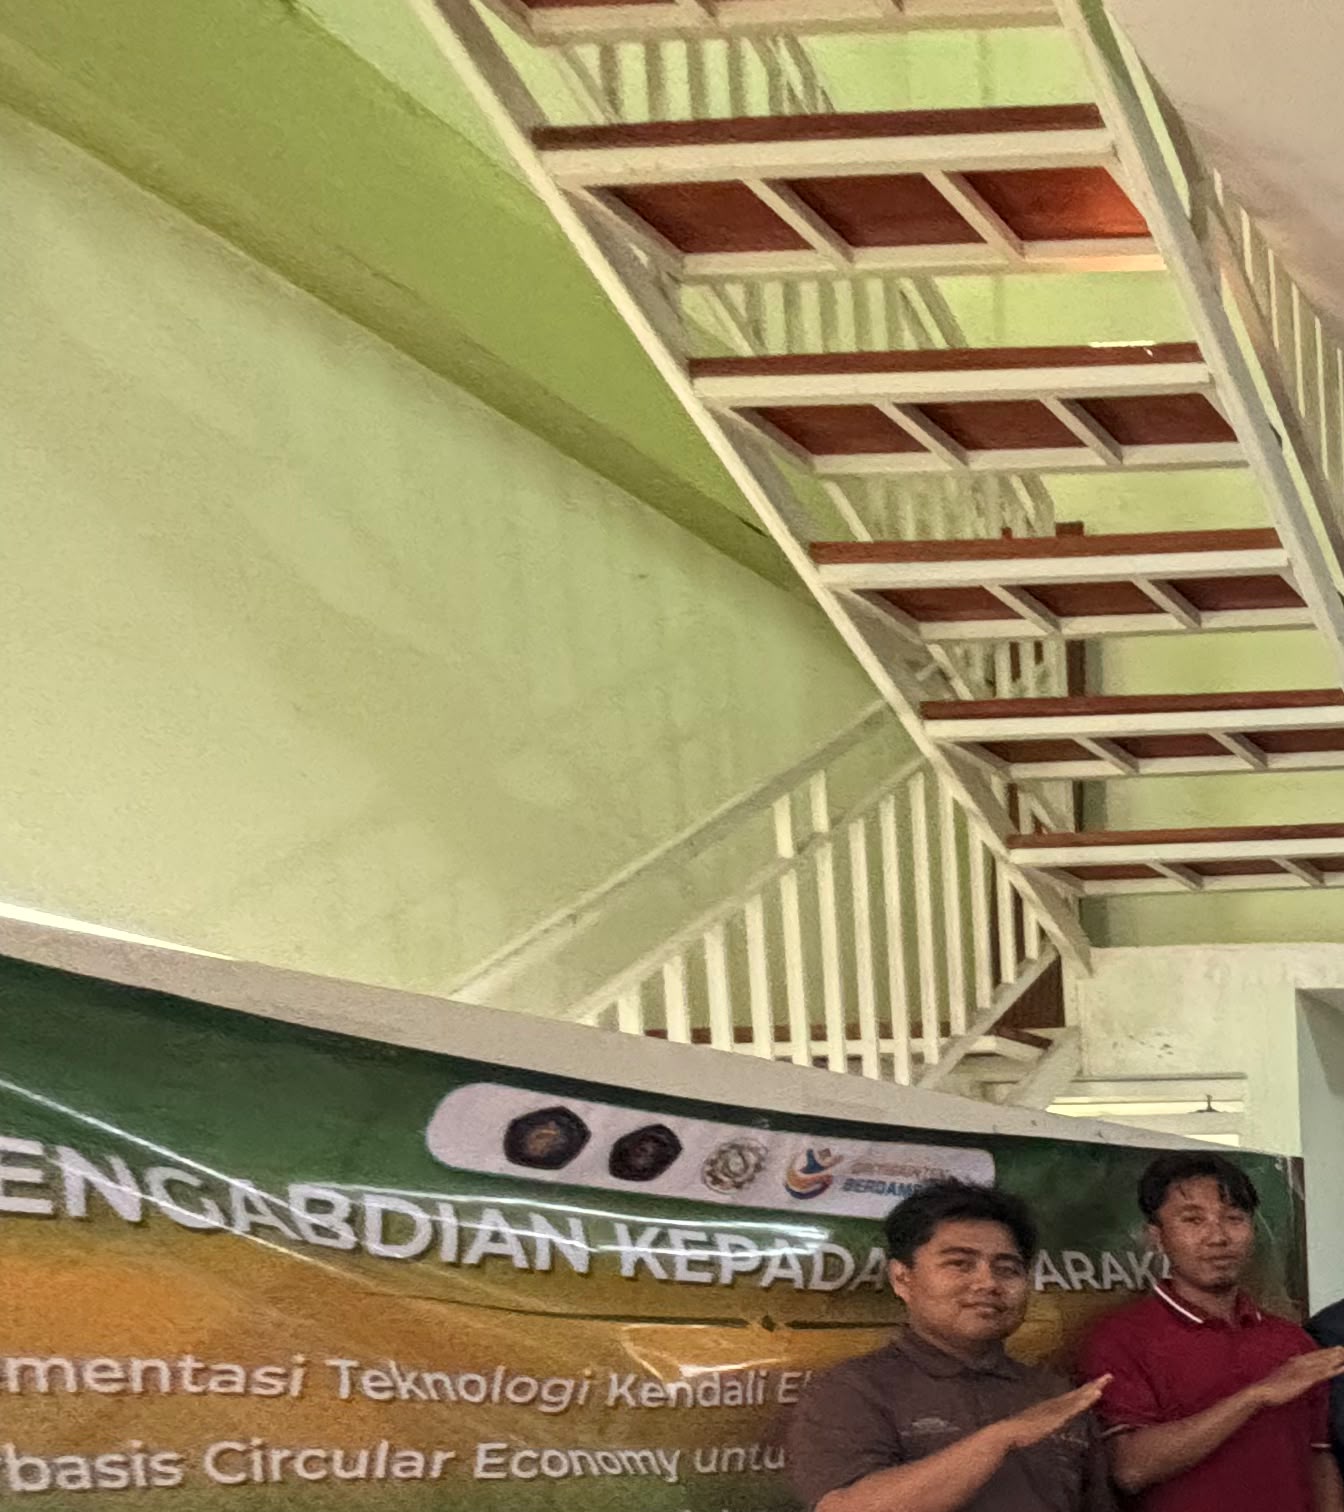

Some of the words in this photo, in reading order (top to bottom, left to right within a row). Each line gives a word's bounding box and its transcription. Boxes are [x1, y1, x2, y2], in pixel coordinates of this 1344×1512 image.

[614, 1222, 887, 1292] KEPADA
[325, 1357, 592, 1414] Teknologi
[606, 1369, 768, 1408] Kendali
[0, 1440, 185, 1492] basis
[203, 1437, 455, 1485] Circular
[473, 1442, 681, 1483] Economy
[695, 1446, 786, 1474] untu
